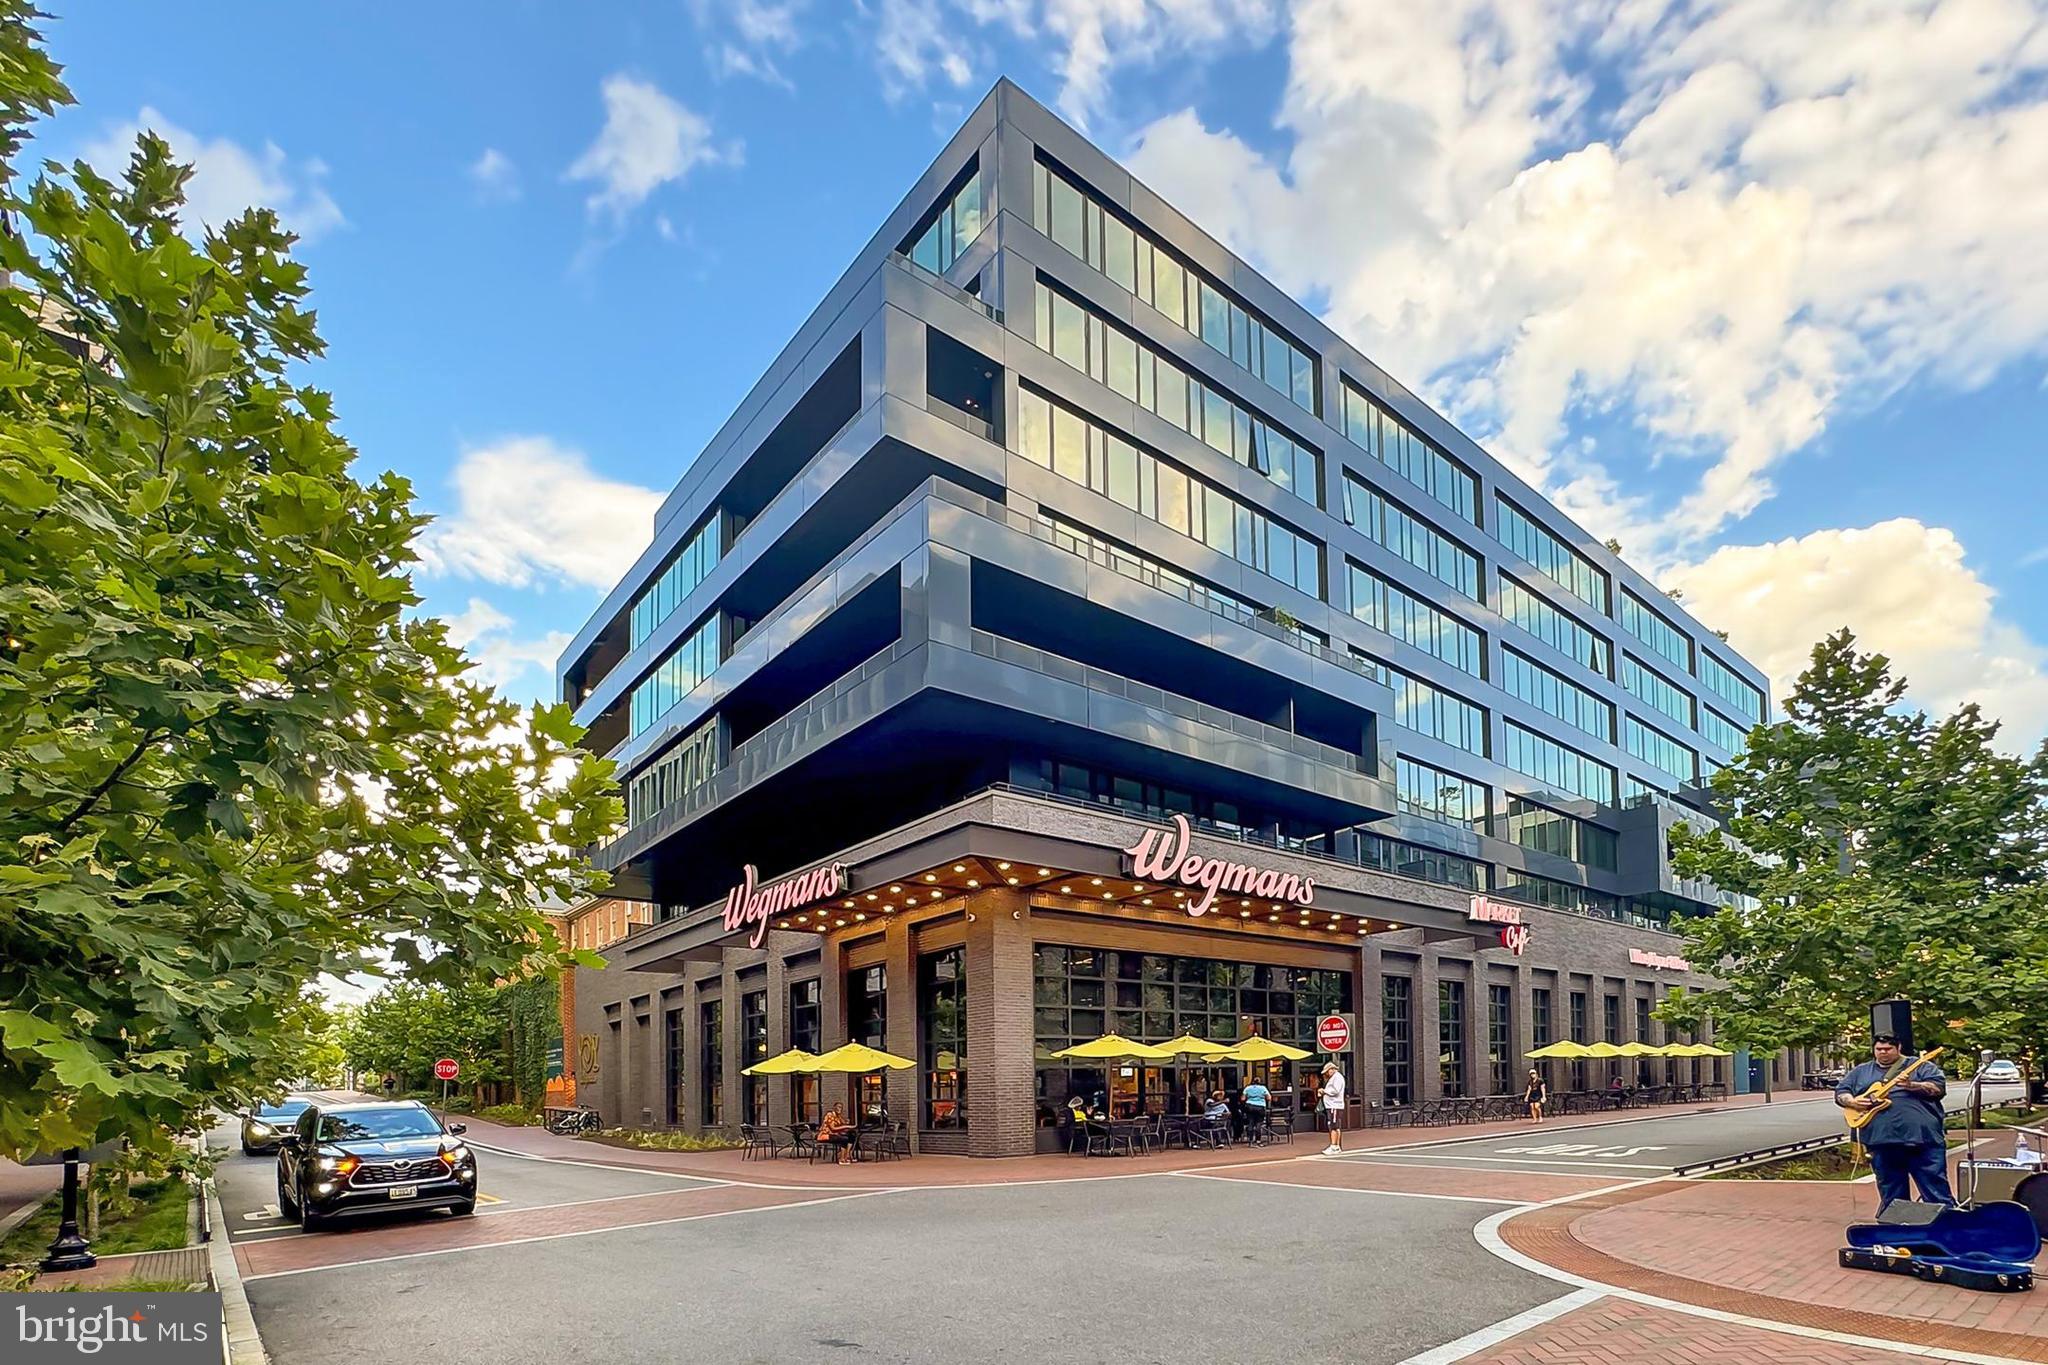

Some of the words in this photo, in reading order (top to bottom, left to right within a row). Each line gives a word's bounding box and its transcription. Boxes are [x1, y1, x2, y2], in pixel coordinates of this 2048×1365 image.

[720, 862, 840, 949] Wegmans
[1123, 814, 1315, 917] Wegmans
[437, 1064, 457, 1073] STOP
